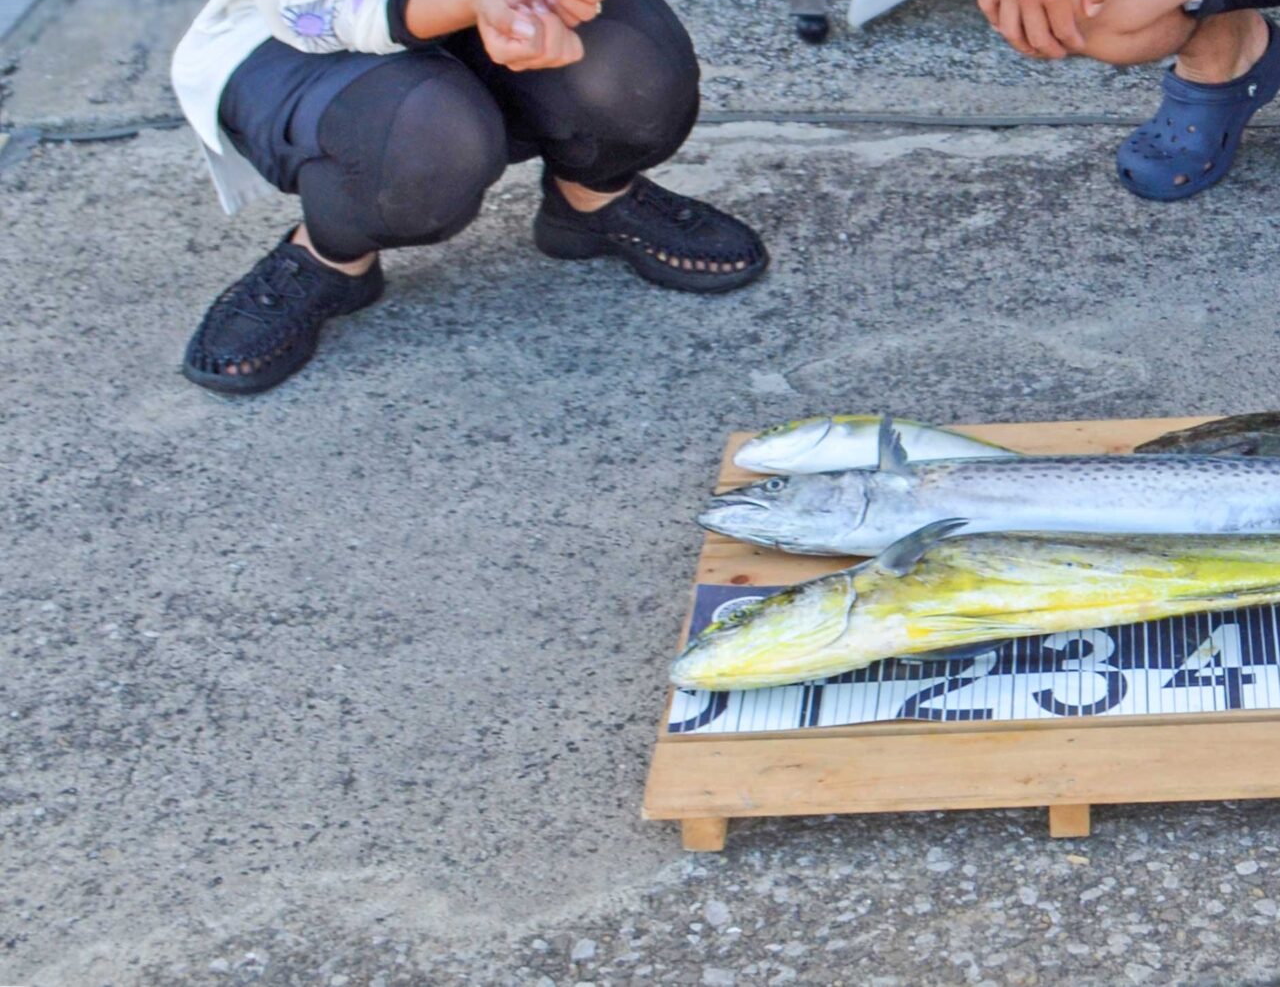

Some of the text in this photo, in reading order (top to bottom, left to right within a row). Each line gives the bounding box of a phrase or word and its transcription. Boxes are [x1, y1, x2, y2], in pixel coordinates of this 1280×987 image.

[896, 650, 993, 721] 2
[1032, 628, 1128, 717] 3
[1161, 622, 1257, 710] 4
